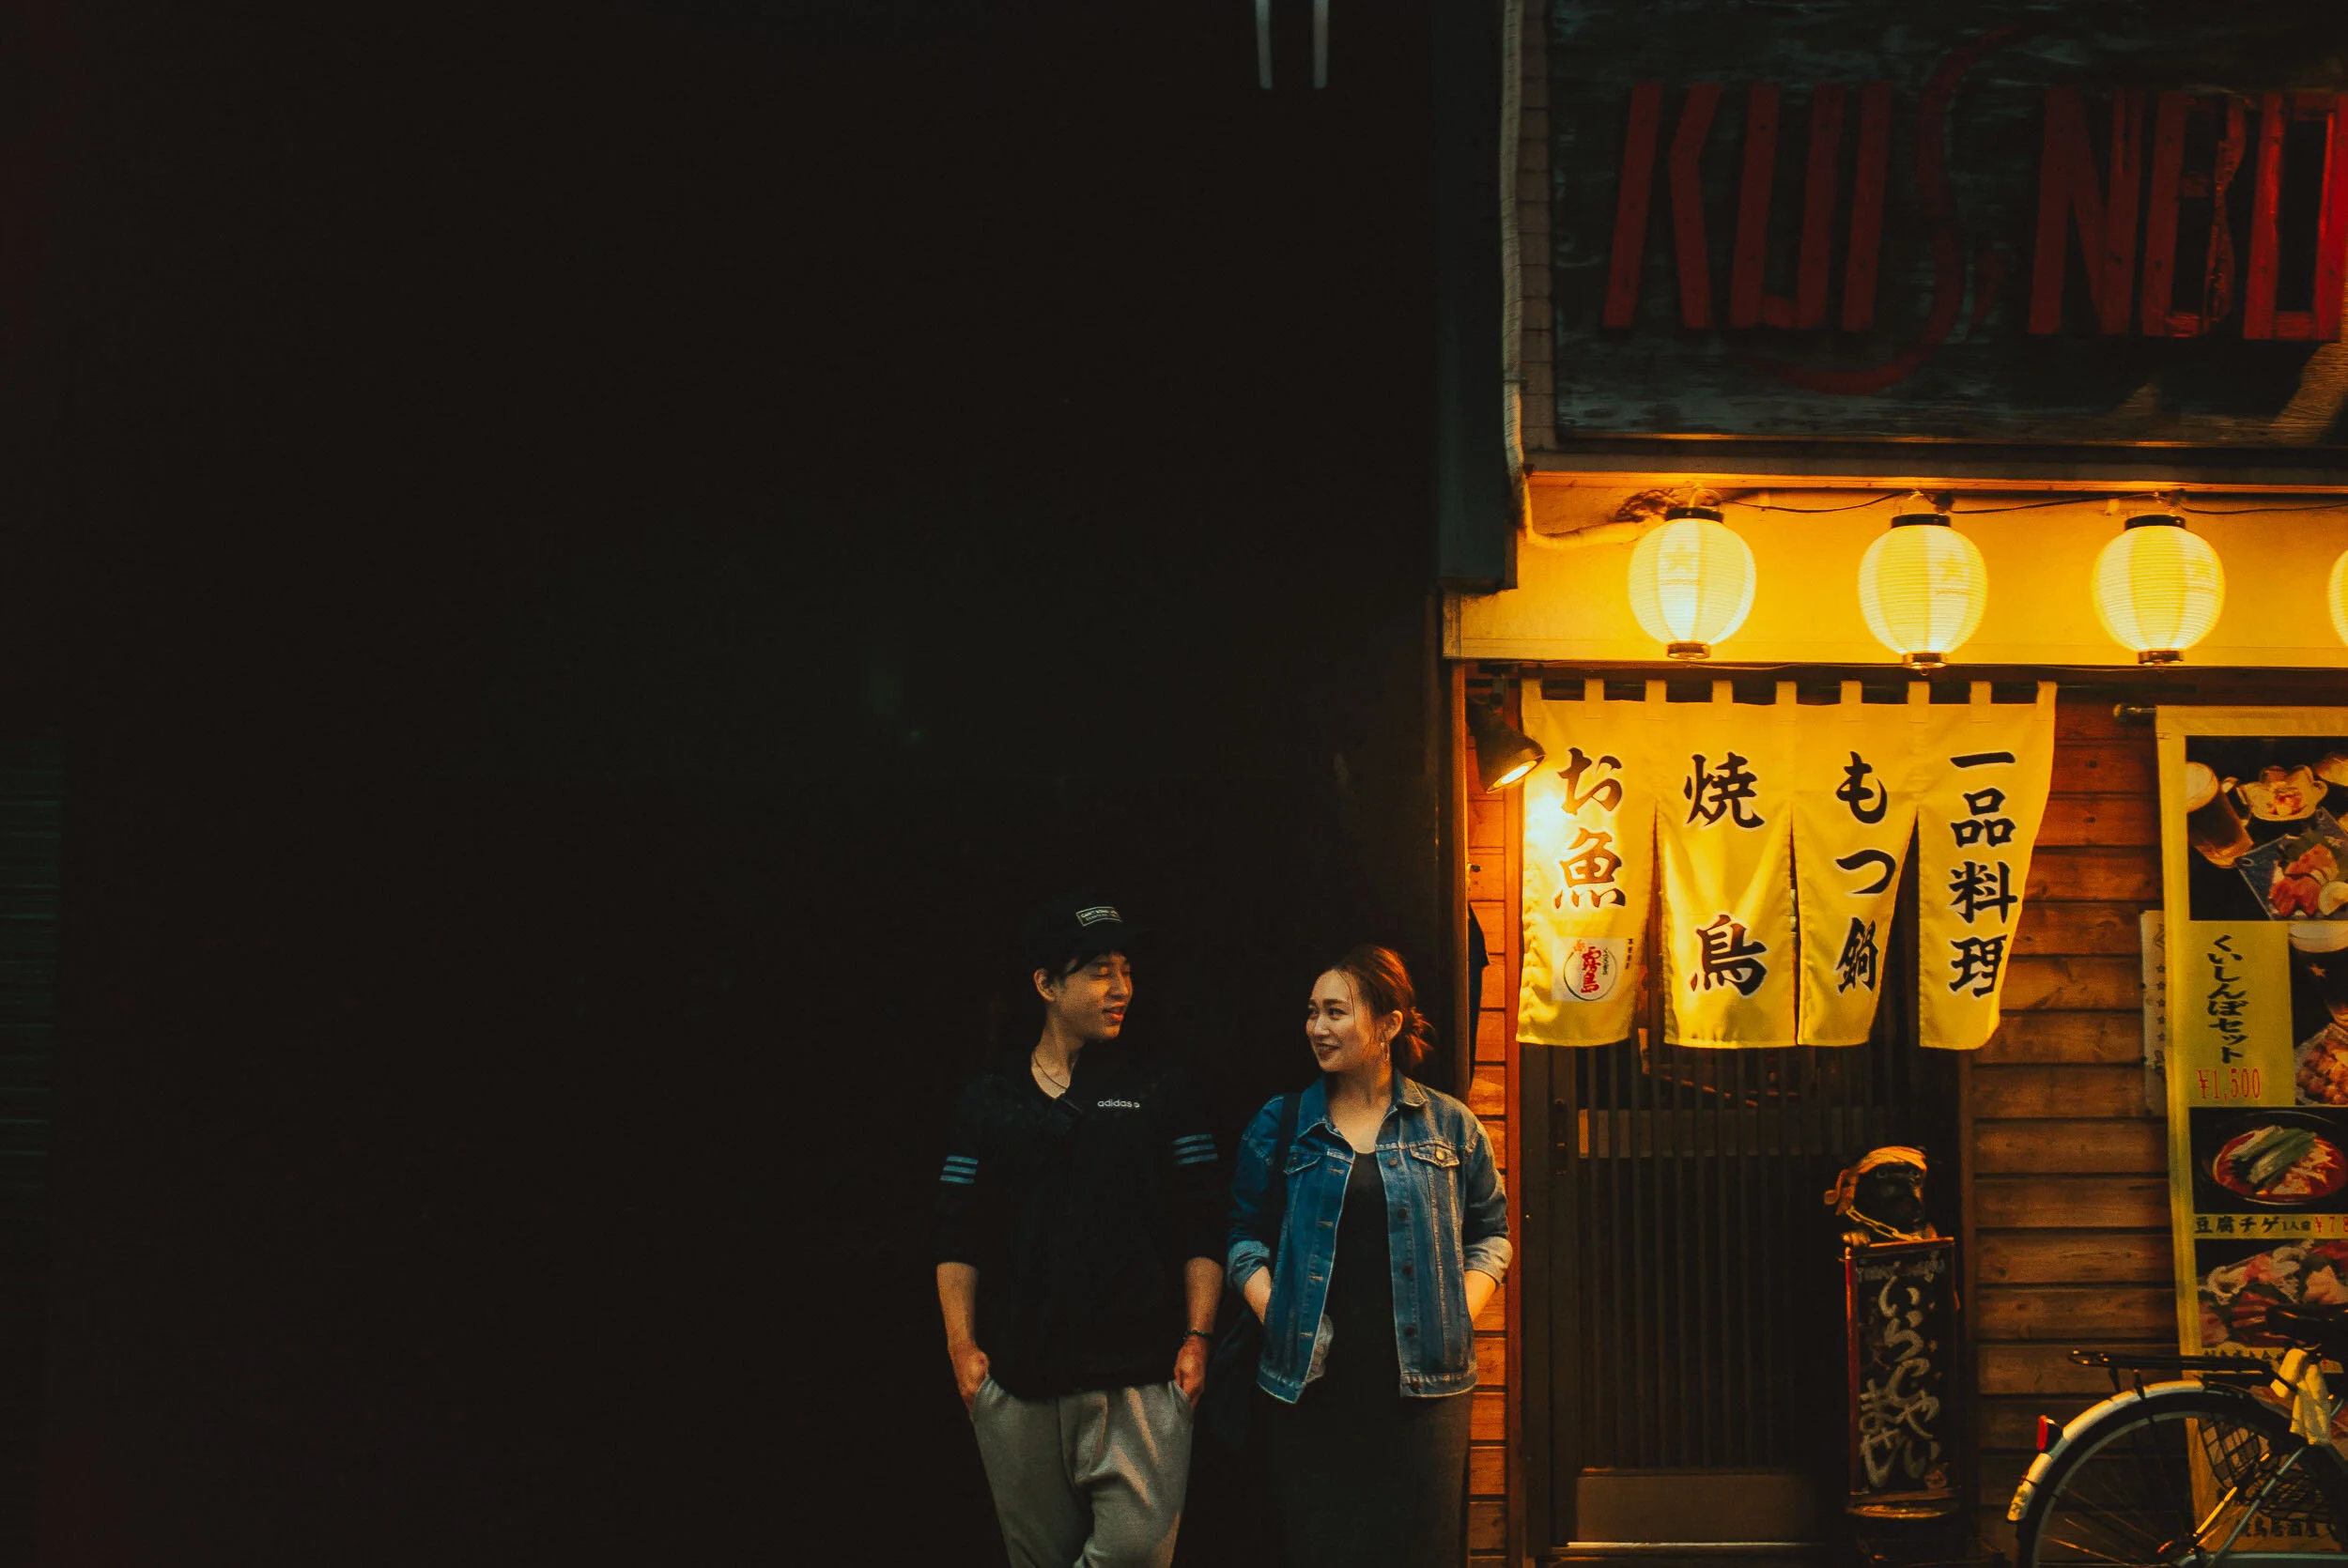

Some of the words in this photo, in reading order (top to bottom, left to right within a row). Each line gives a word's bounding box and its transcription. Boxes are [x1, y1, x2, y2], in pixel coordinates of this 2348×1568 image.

[1552, 747, 1626, 911] お魚
[1683, 751, 1768, 996] 焼鳥
[1835, 751, 1896, 994] もつ鍋
[1949, 751, 2018, 998] 一品料理
[2207, 934, 2249, 1064] くいしんぼセット
[1097, 1099, 1133, 1108] adidas
[2198, 1068, 2261, 1100] ¥1,500
